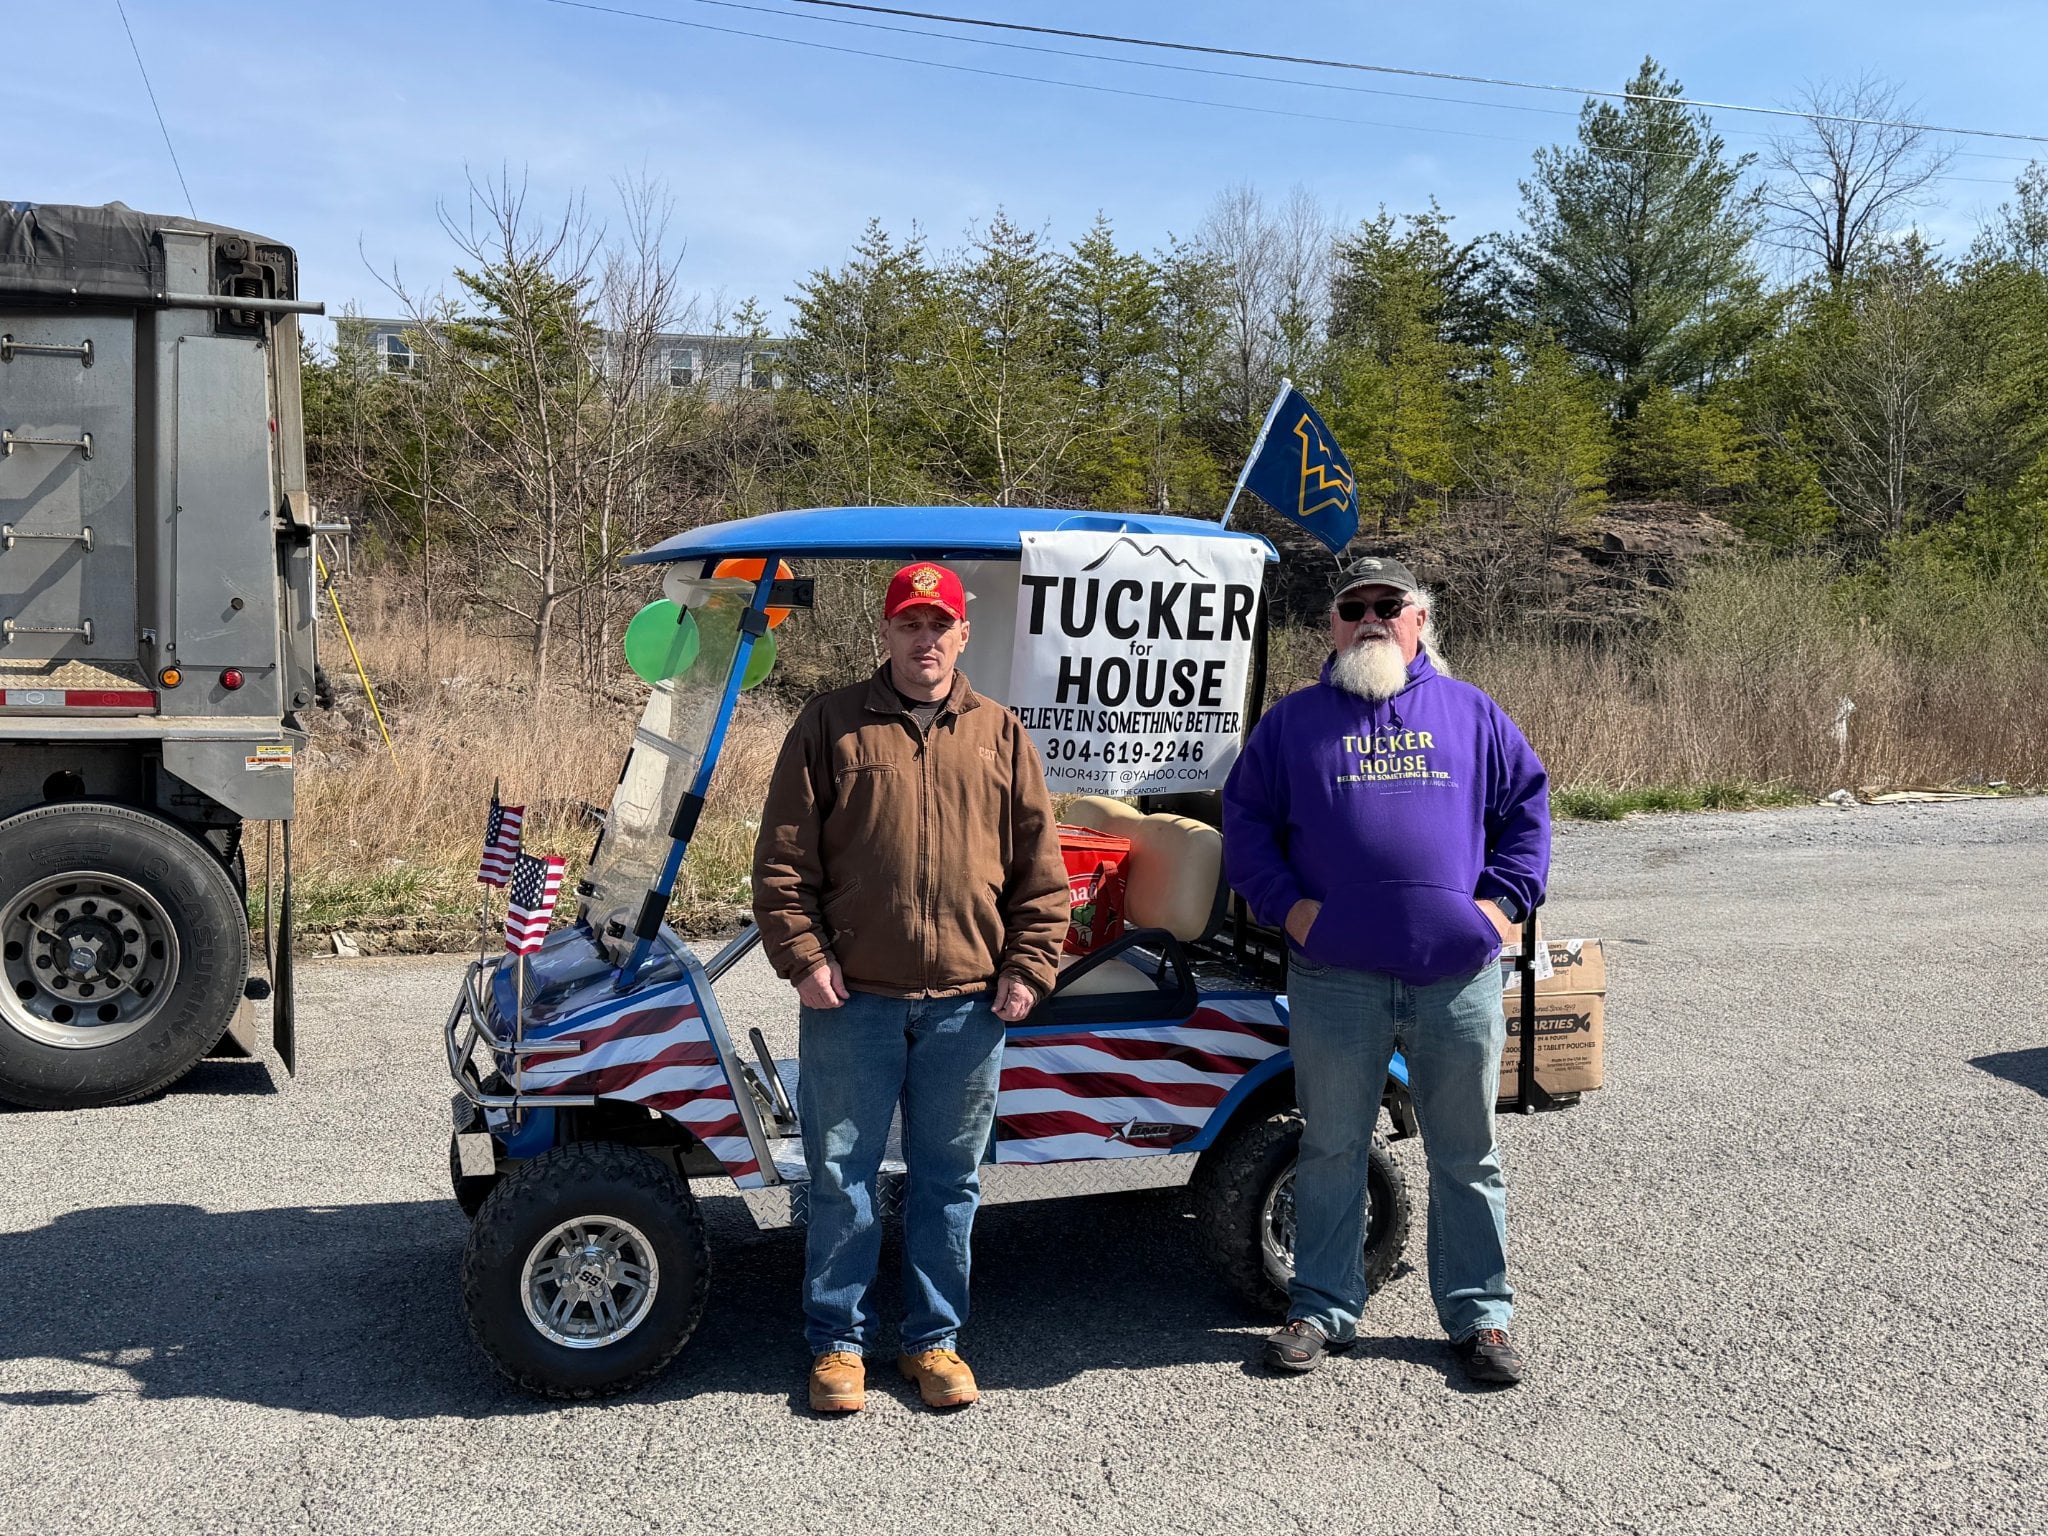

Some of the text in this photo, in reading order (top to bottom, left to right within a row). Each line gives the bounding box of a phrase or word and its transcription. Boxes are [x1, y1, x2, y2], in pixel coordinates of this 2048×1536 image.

[1021, 574, 1255, 641] TUCKER
[1129, 641, 1153, 656] for
[1055, 655, 1226, 708] HOUSE
[1076, 709, 1095, 732] IN
[1096, 710, 1183, 733] SOMETHING
[1046, 737, 1204, 764] 304-619-2246
[1342, 731, 1435, 754] TUCKER
[1360, 754, 1427, 774] HOUSE
[1337, 774, 1367, 783] BELIEVE
[1377, 771, 1420, 781] SOMETHING
[1134, 786, 1167, 794] CANDIDATE
[1511, 1018, 1575, 1032] SRTIES
[1543, 1043, 1565, 1051] TABLET
[1566, 1041, 1596, 1050] POUCHES
